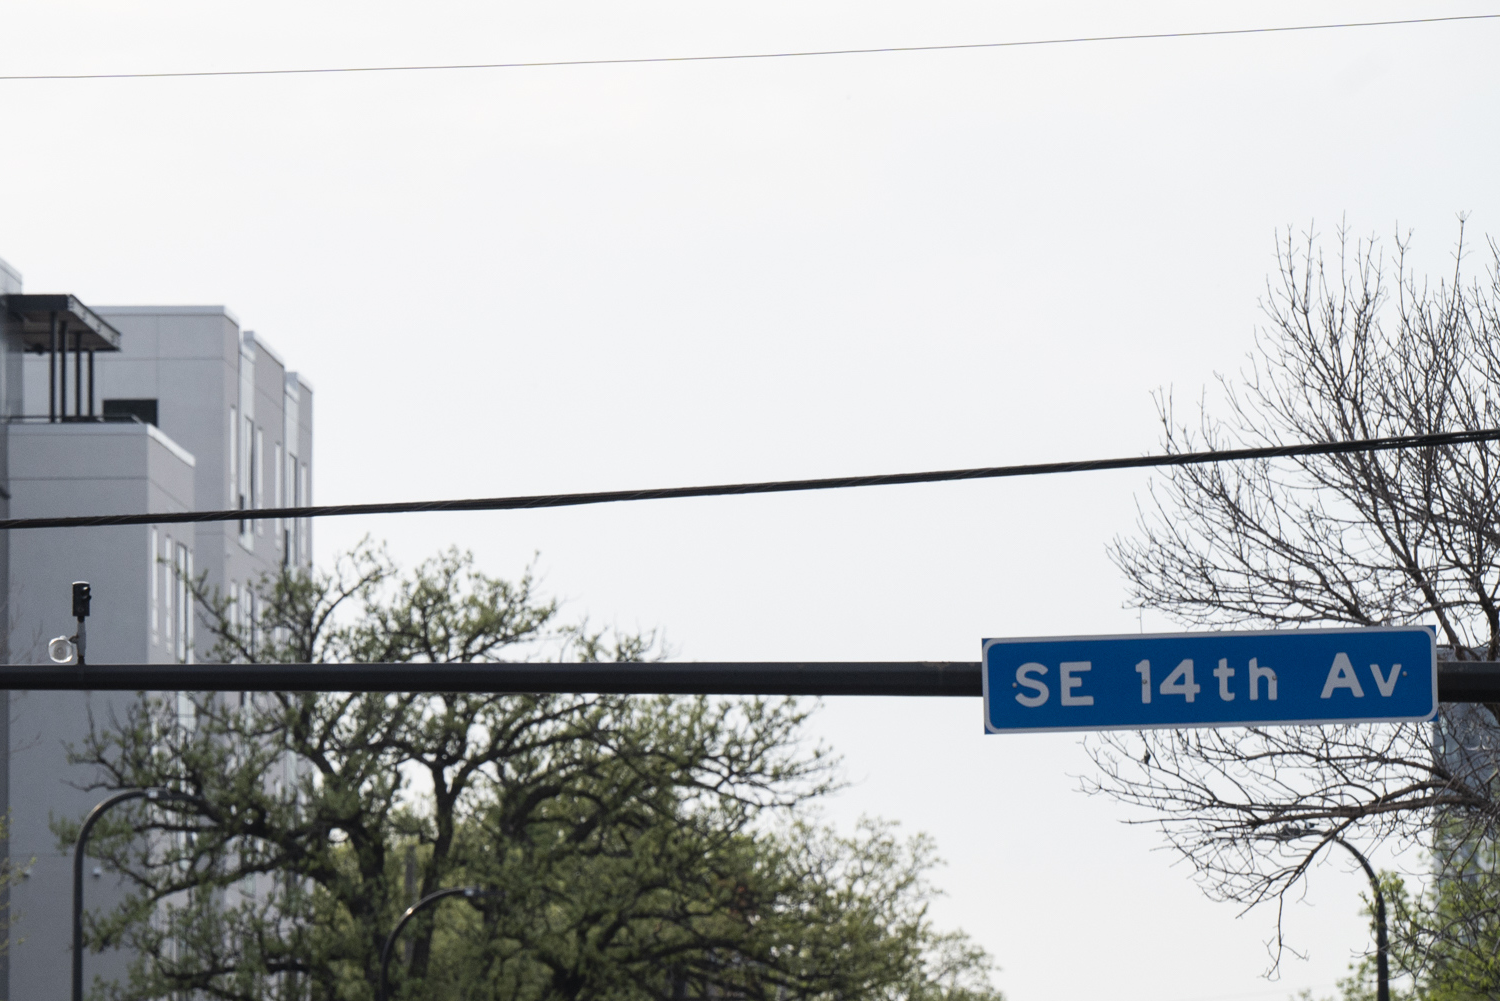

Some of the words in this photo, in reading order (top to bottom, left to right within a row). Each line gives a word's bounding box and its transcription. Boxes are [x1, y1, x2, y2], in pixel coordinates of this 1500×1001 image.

[1015, 660, 1094, 708] SE
[1135, 657, 1279, 704] 14th
[1320, 652, 1403, 699] Av
